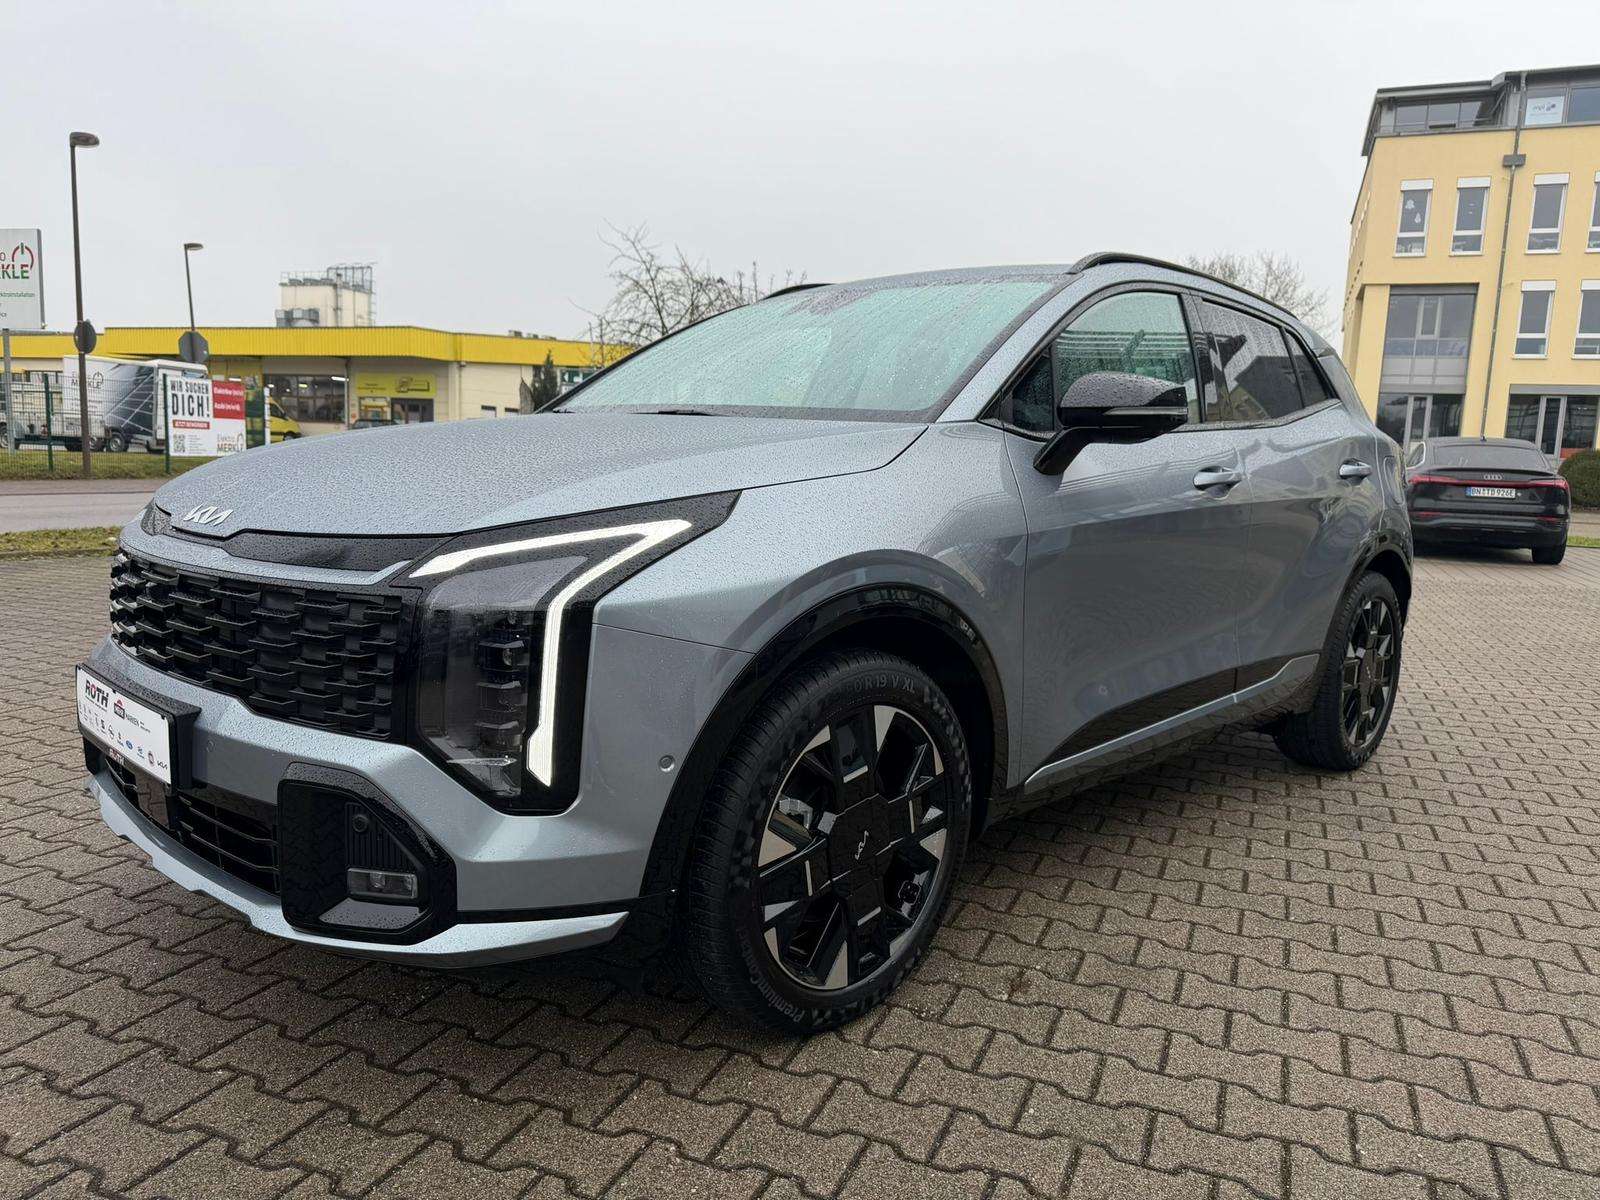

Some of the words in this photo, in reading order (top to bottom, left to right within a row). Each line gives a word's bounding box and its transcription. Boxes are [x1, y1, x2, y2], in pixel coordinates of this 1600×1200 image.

[0, 263, 29, 279] KLE
[171, 380, 183, 392] WIR
[185, 382, 209, 394] SUCHEN
[172, 393, 210, 418] DICH!
[84, 679, 110, 709] ROTH
